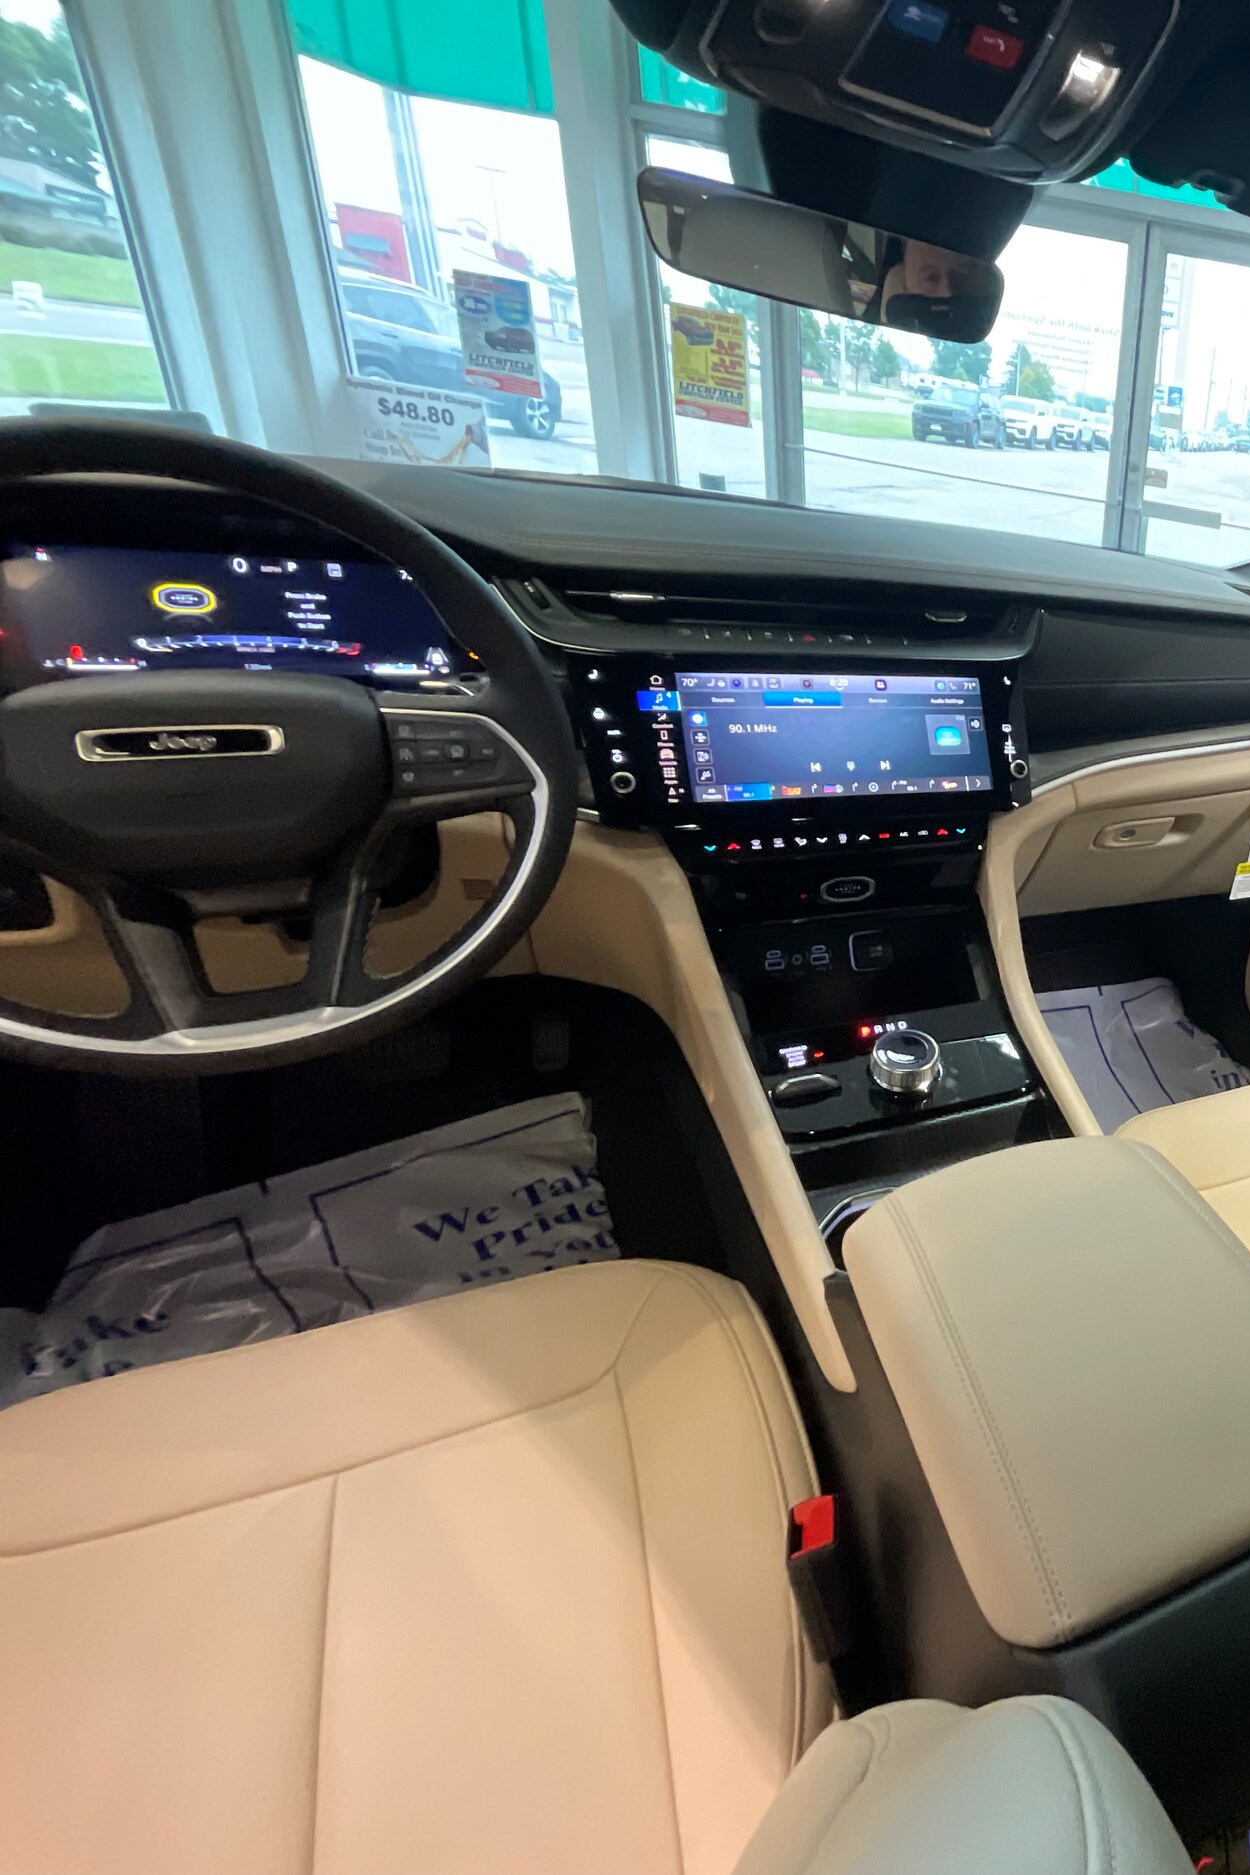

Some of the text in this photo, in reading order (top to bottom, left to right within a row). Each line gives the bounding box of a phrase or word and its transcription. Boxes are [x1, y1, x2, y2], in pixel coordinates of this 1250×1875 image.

[469, 352, 534, 371] LITCHFIELD
[679, 381, 744, 400] LITCHFIELD
[377, 397, 455, 427] $48.80
[681, 678, 699, 687] 70°
[793, 696, 814, 705] Playing
[729, 723, 778, 734] 90.1 MHz
[150, 732, 217, 751] Jeep
[874, 1024, 883, 1034] R
[886, 1022, 896, 1031] N
[897, 1020, 908, 1030] D
[412, 1164, 600, 1243] We Tak
[471, 1200, 610, 1262] Pride
